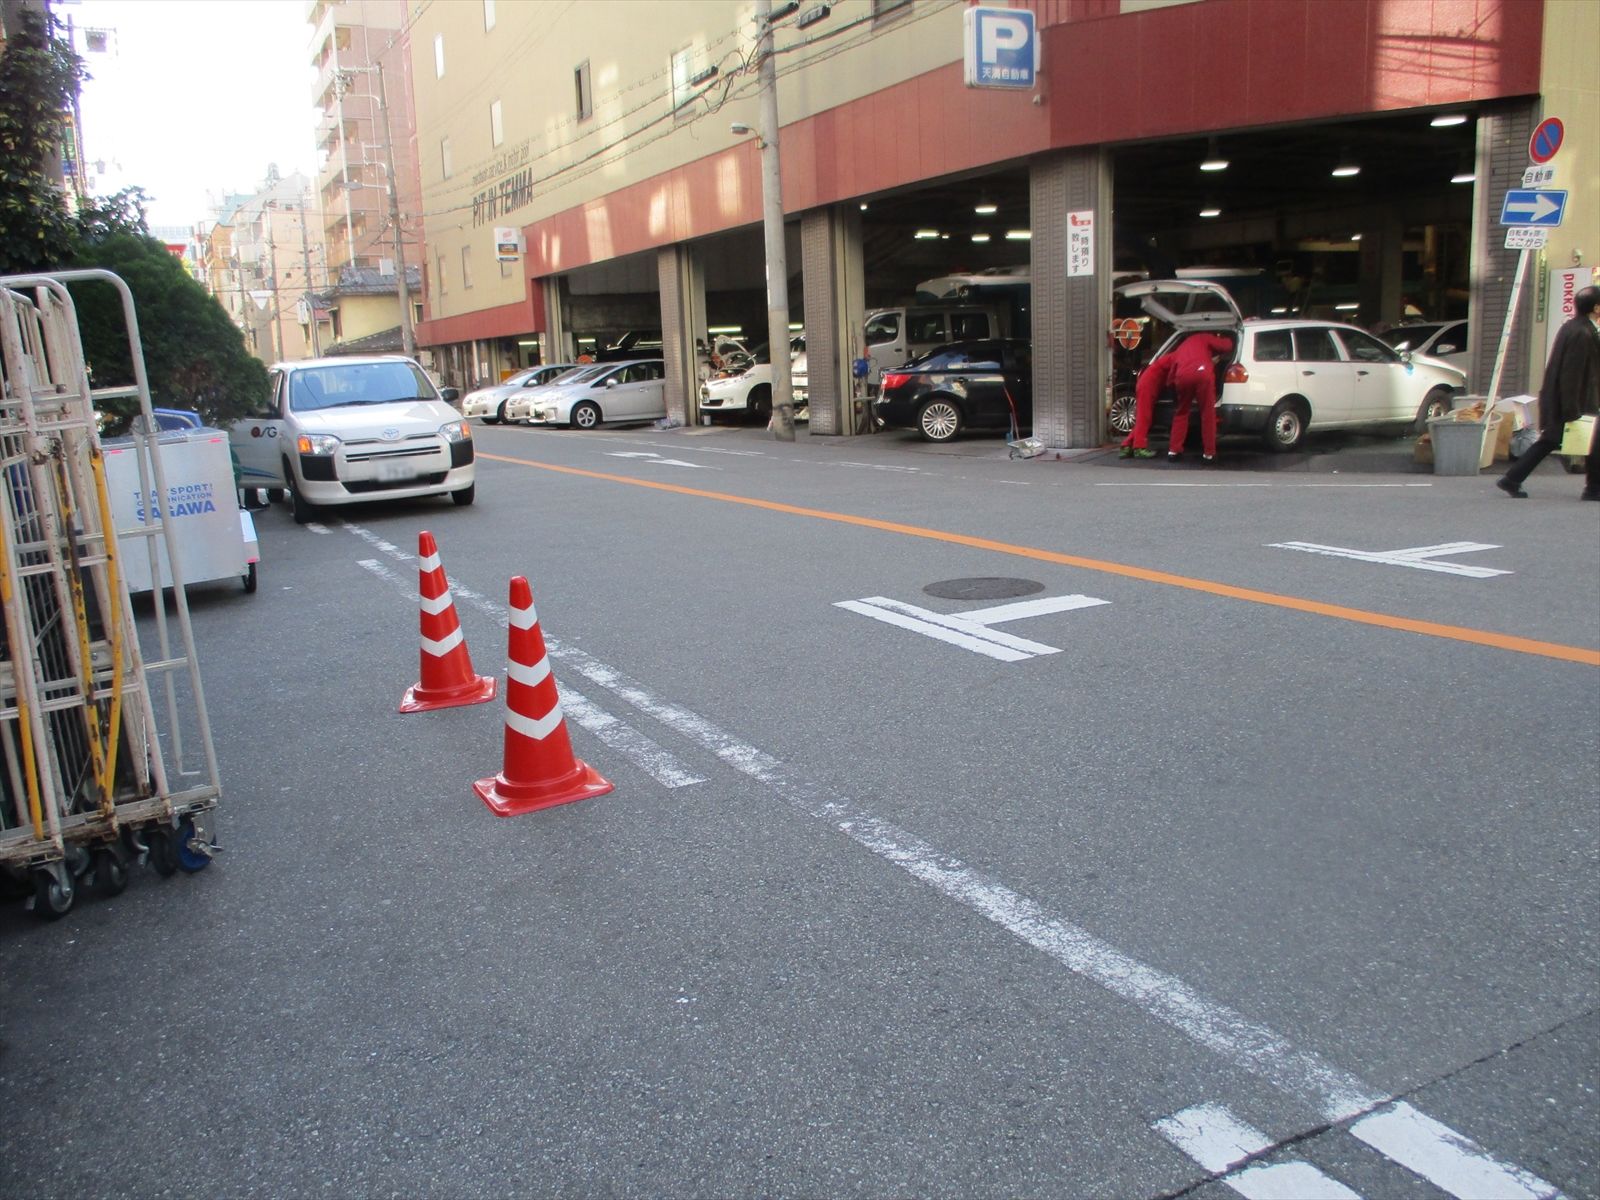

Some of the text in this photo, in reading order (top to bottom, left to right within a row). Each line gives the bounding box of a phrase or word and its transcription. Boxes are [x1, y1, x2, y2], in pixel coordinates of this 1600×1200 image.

[982, 16, 1029, 64] P
[1525, 170, 1554, 183] 自動車
[473, 167, 533, 229] PIT IN TEMMA
[1506, 238, 1543, 247] ここから
[134, 483, 213, 500] TASPORT!
